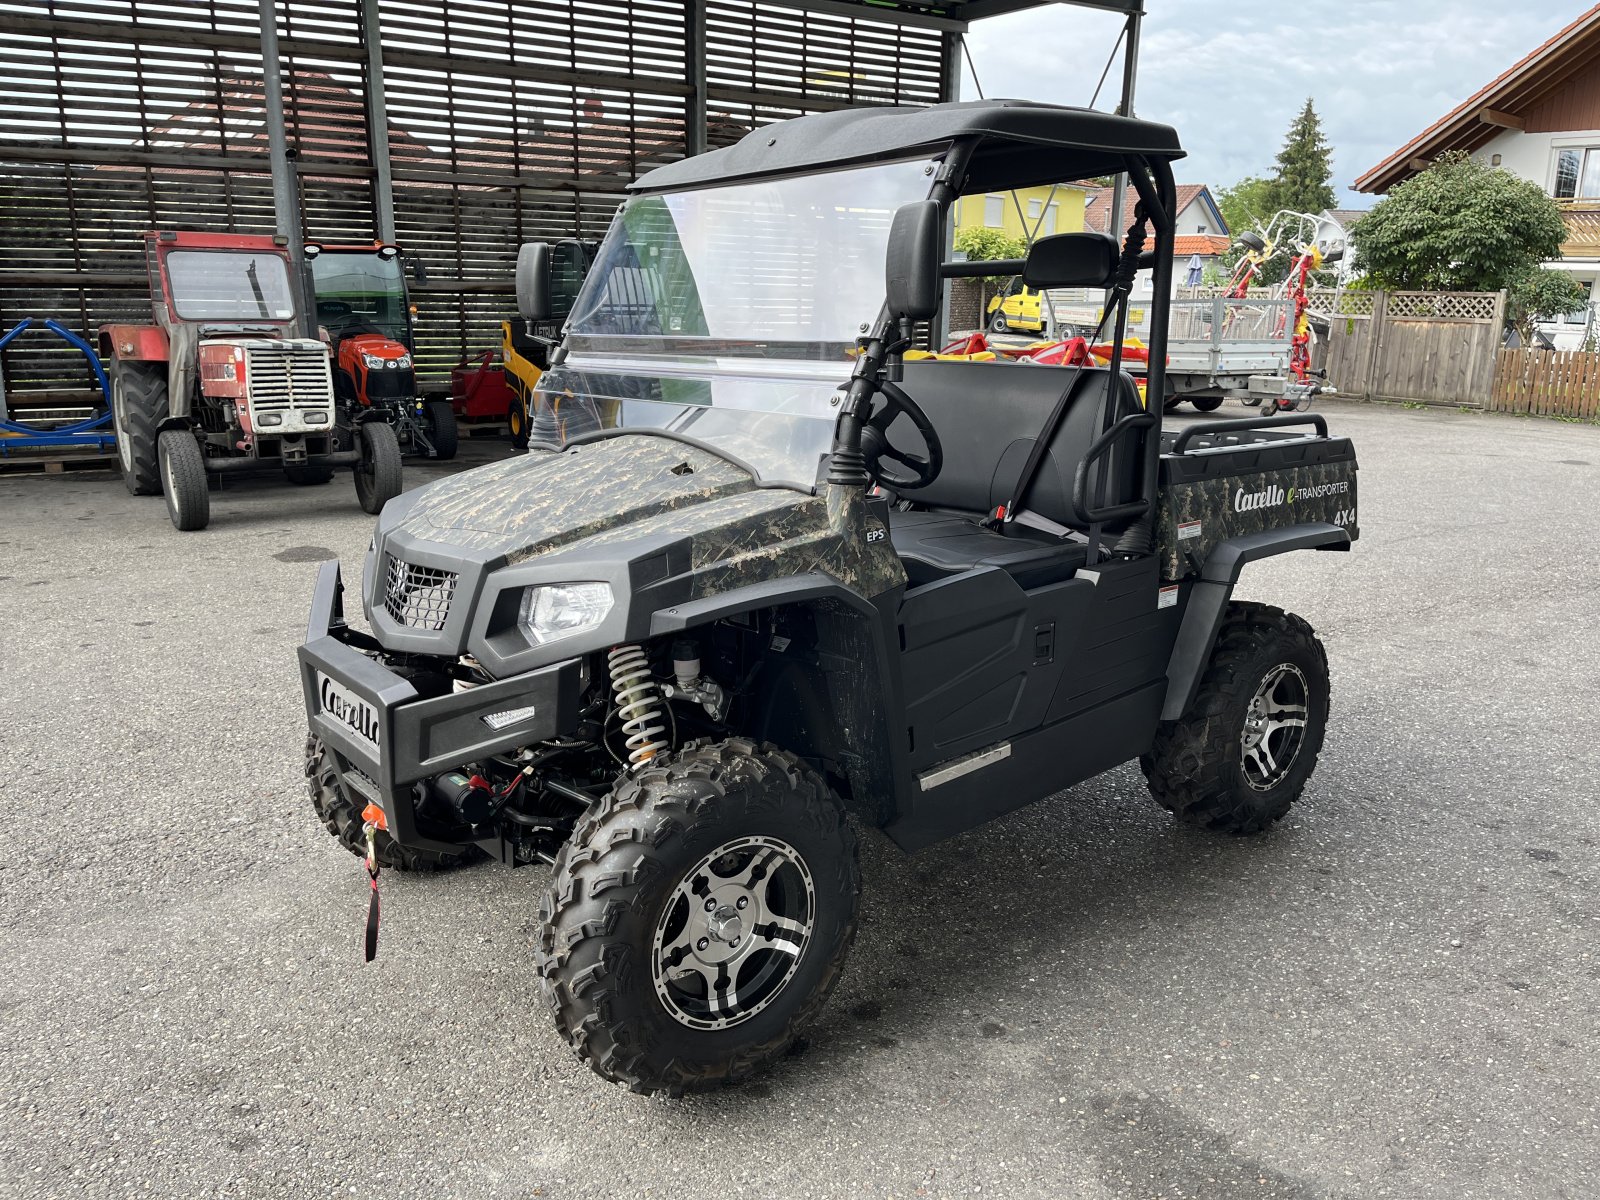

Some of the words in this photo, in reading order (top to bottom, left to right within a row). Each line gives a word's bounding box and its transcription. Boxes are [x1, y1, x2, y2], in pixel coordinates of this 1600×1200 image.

[1235, 485, 1285, 512] Carello
[1334, 508, 1355, 527] 4X4
[867, 529, 884, 542] EPS
[322, 677, 380, 746] Carello
